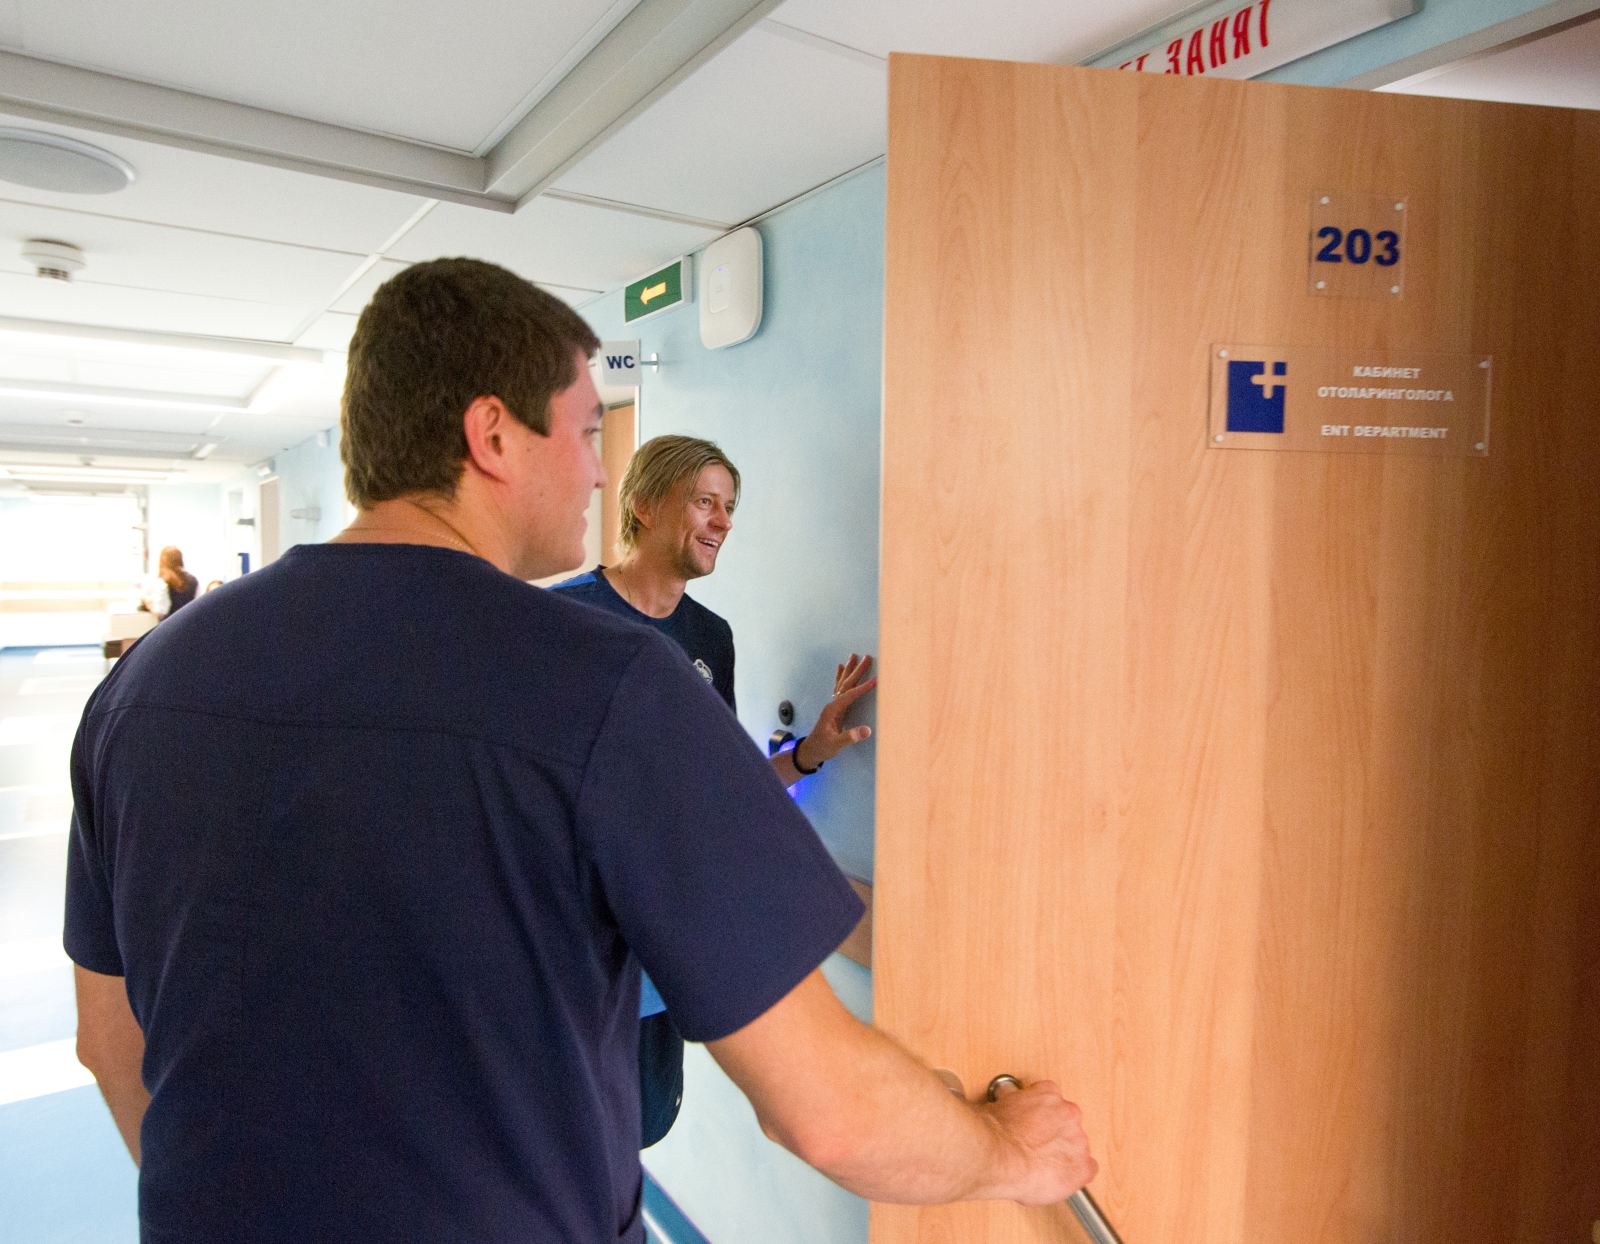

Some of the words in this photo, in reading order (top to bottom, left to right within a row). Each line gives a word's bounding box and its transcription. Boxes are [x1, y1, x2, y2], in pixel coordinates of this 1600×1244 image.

[1165, 0, 1272, 76] ЗАНЯТ
[1316, 226, 1400, 267] 203
[606, 355, 635, 370] WC
[1353, 365, 1421, 379] КАБИНЕТ
[1317, 386, 1455, 401] ОТОЛАРИНГОЛОГА
[1321, 425, 1350, 436] ENT
[1354, 425, 1448, 439] DEPARTMENT
